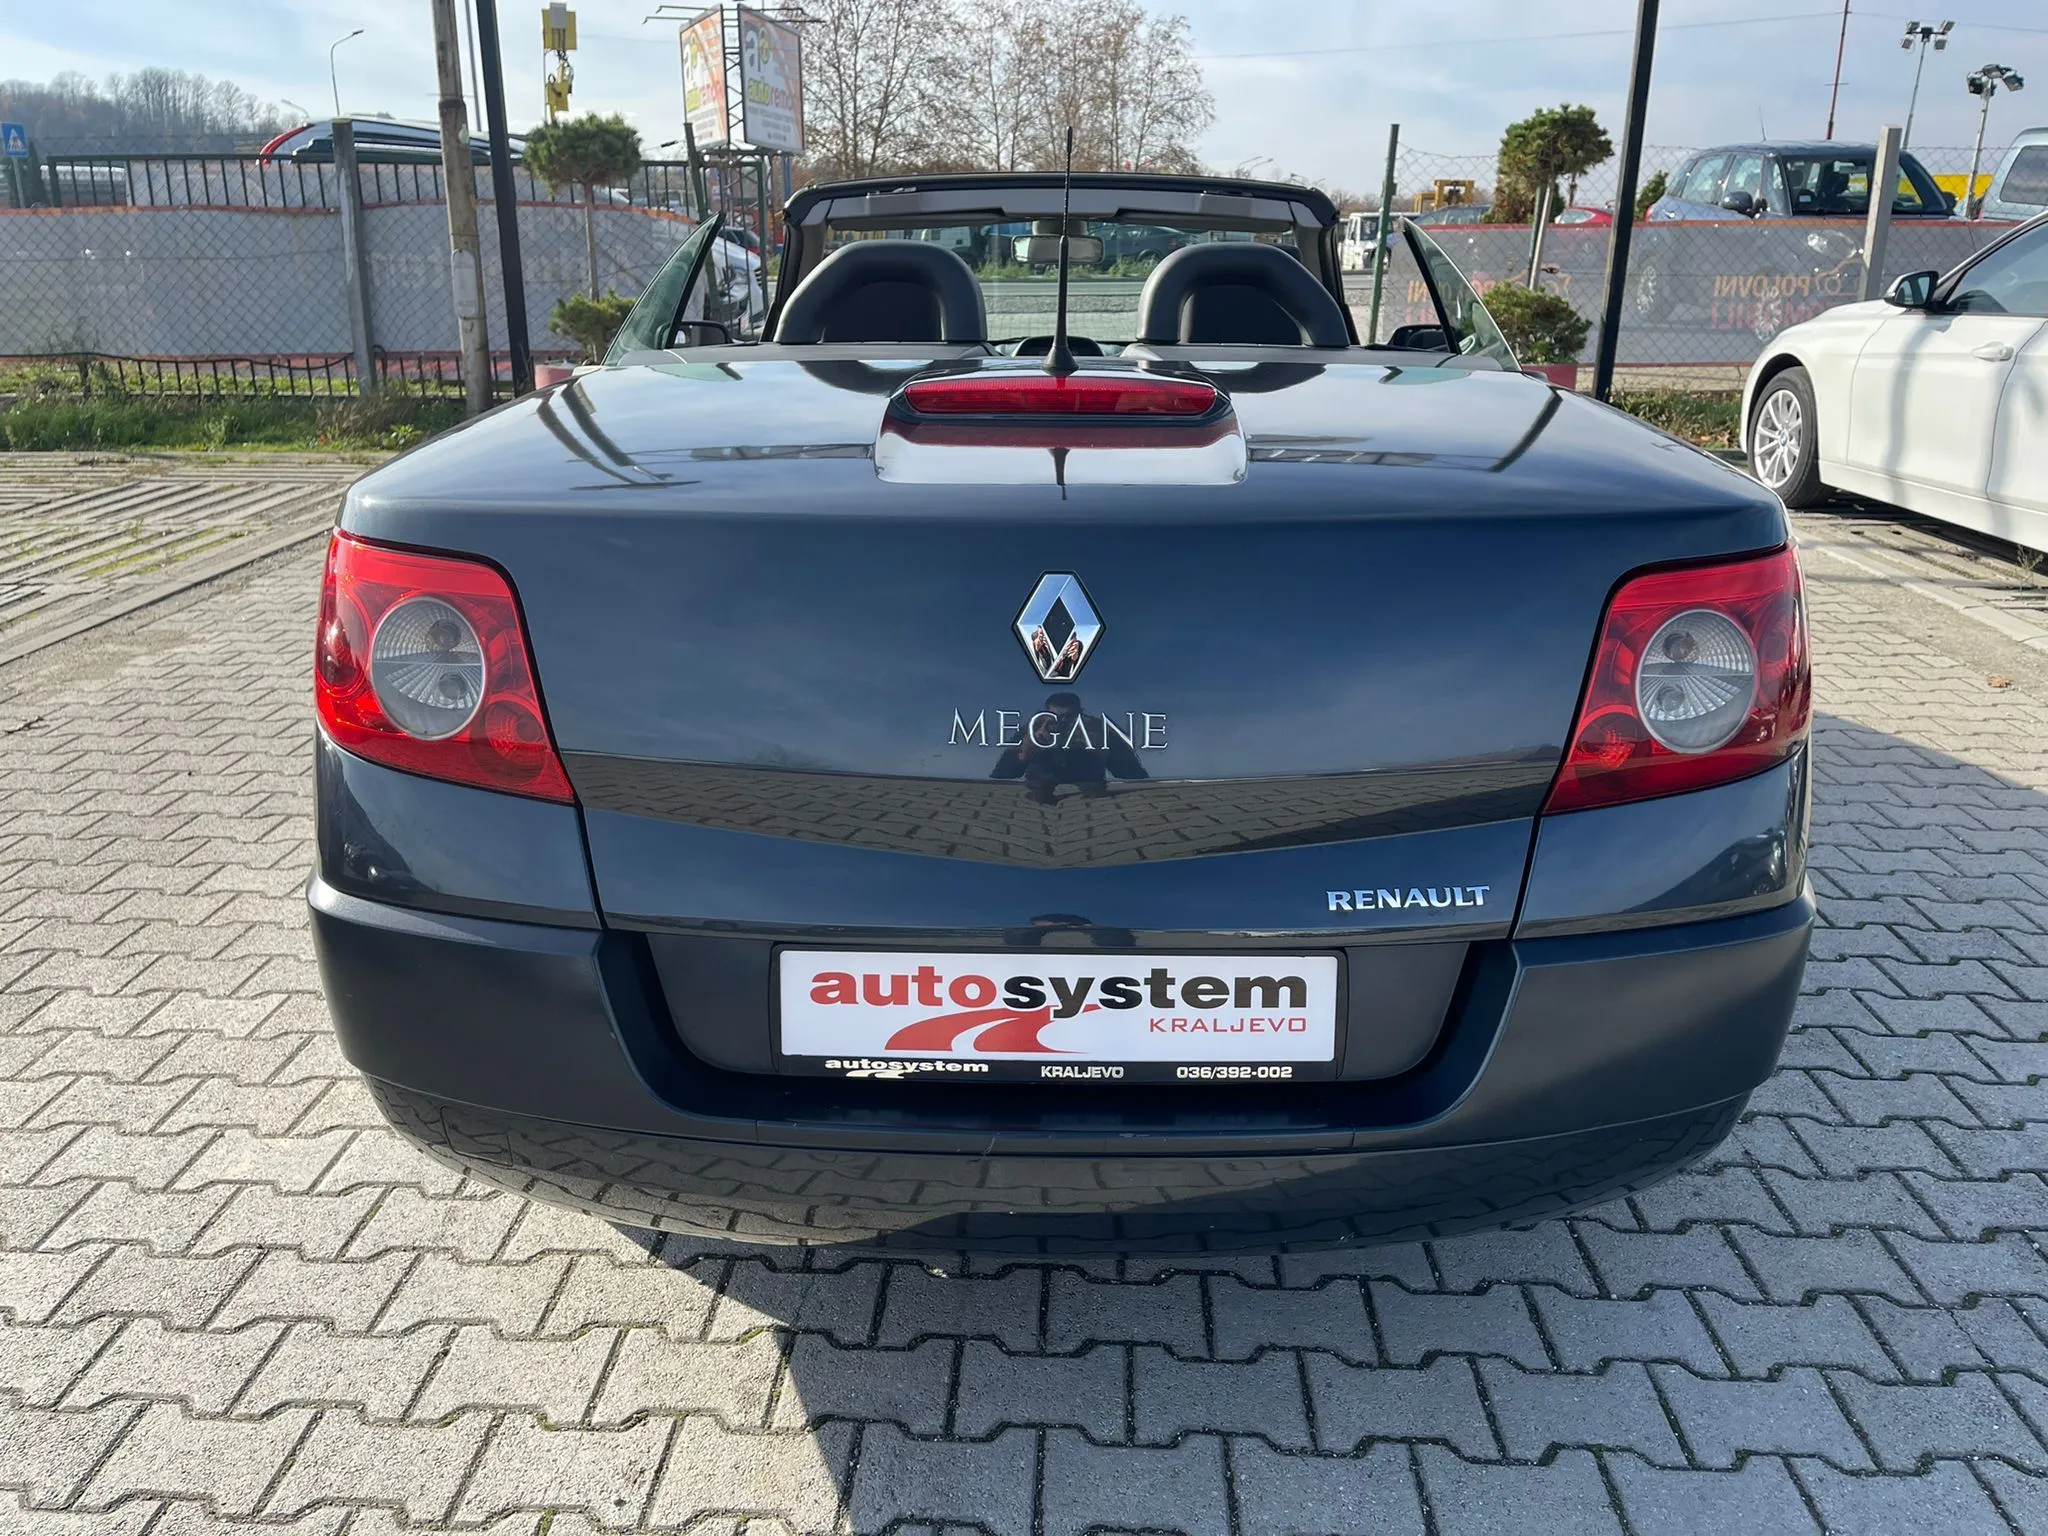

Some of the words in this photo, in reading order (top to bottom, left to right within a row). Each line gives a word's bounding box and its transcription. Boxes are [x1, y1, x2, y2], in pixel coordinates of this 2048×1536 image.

[948, 707, 1168, 750] MEGANE
[1326, 885, 1490, 911] RENAULT
[809, 965, 1308, 1019] autosystem
[1150, 1017, 1307, 1033] KRALJEVO
[824, 1058, 989, 1073] autosystem
[1040, 1065, 1125, 1079] KRALJEVO
[1176, 1065, 1293, 1080] 036/392-002
